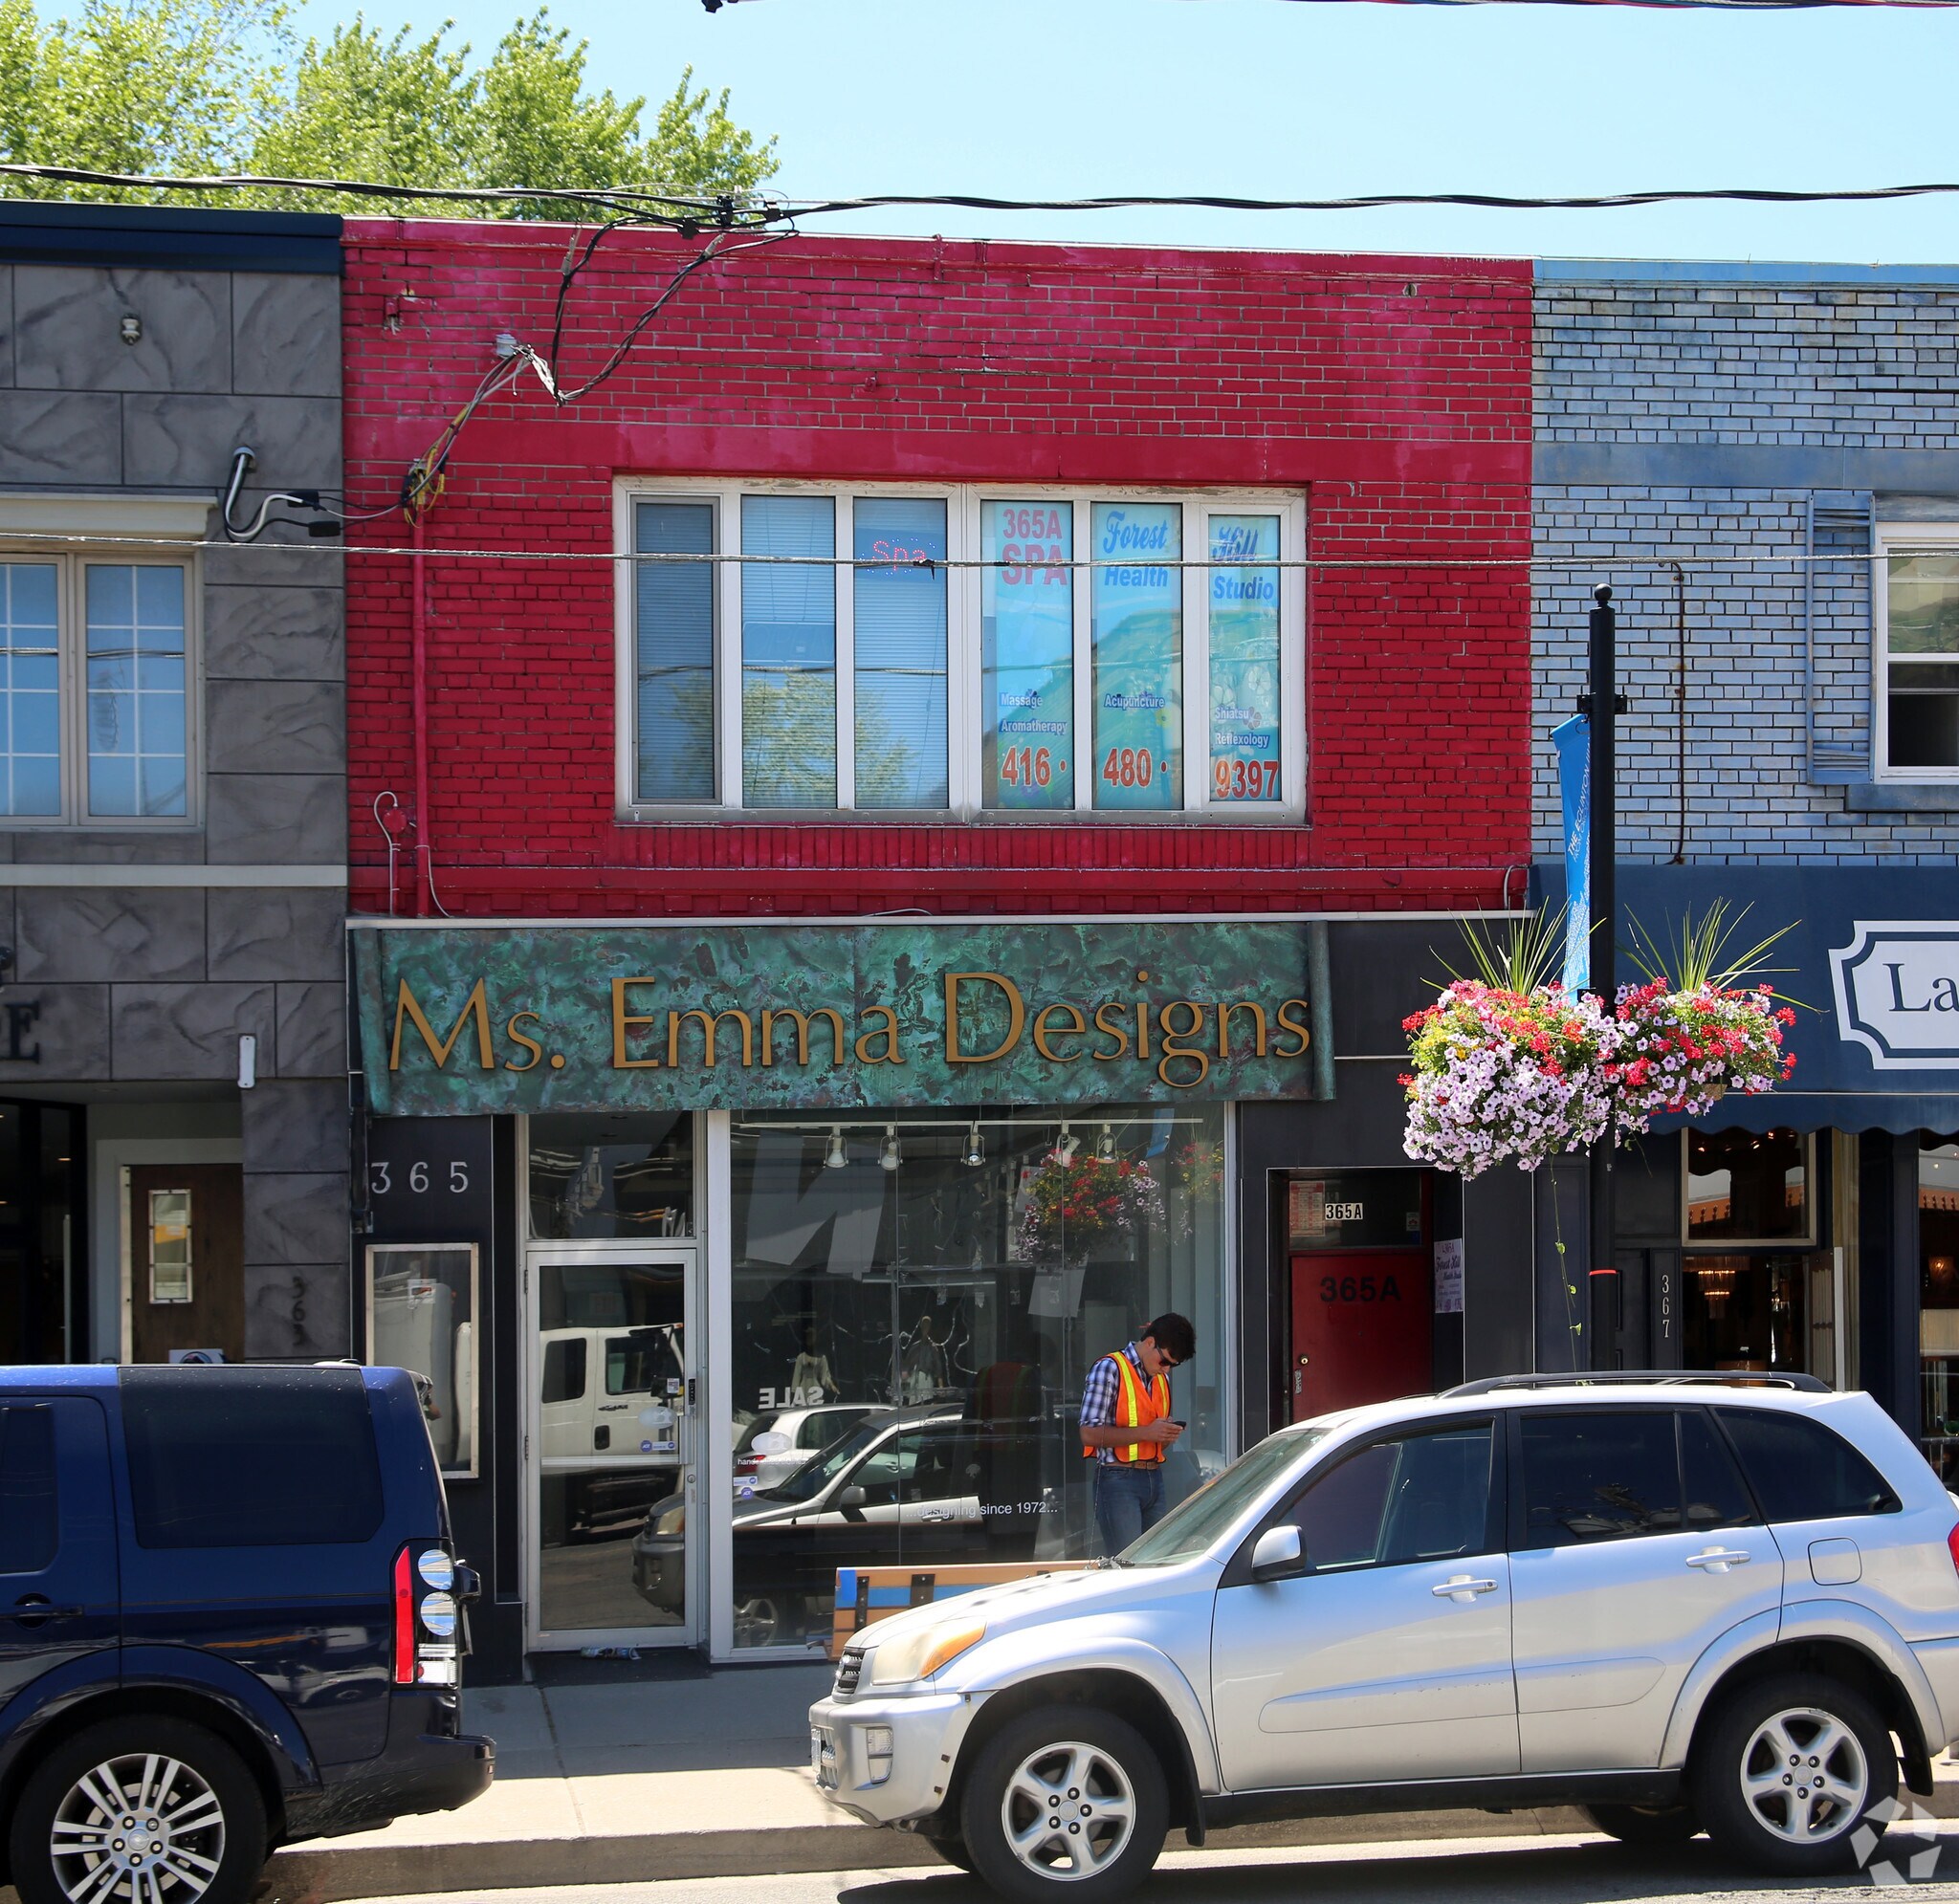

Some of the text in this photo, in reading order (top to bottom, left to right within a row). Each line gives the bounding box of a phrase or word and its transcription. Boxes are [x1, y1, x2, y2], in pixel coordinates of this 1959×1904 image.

[1002, 509, 1063, 539] 365A
[1103, 511, 1259, 561] Forest Hill
[872, 540, 927, 571] Spa
[1001, 544, 1068, 585] SPA
[1104, 565, 1274, 600] Health Studio
[1001, 693, 1044, 709] Massage
[1104, 694, 1165, 710] Acupuncture
[1214, 707, 1249, 720] Shiatsu
[1001, 719, 1068, 734] Aromatherapy
[1214, 732, 1269, 748] Reflexology
[1002, 746, 1280, 799] 416 480 9397
[388, 971, 1310, 1088] Ms. Emma Designs
[1325, 1204, 1362, 1219] 365A
[1320, 1275, 1401, 1302] 365A
[1662, 1274, 1670, 1339] 367
[905, 1501, 1058, 1520] ...designing since 1972...
